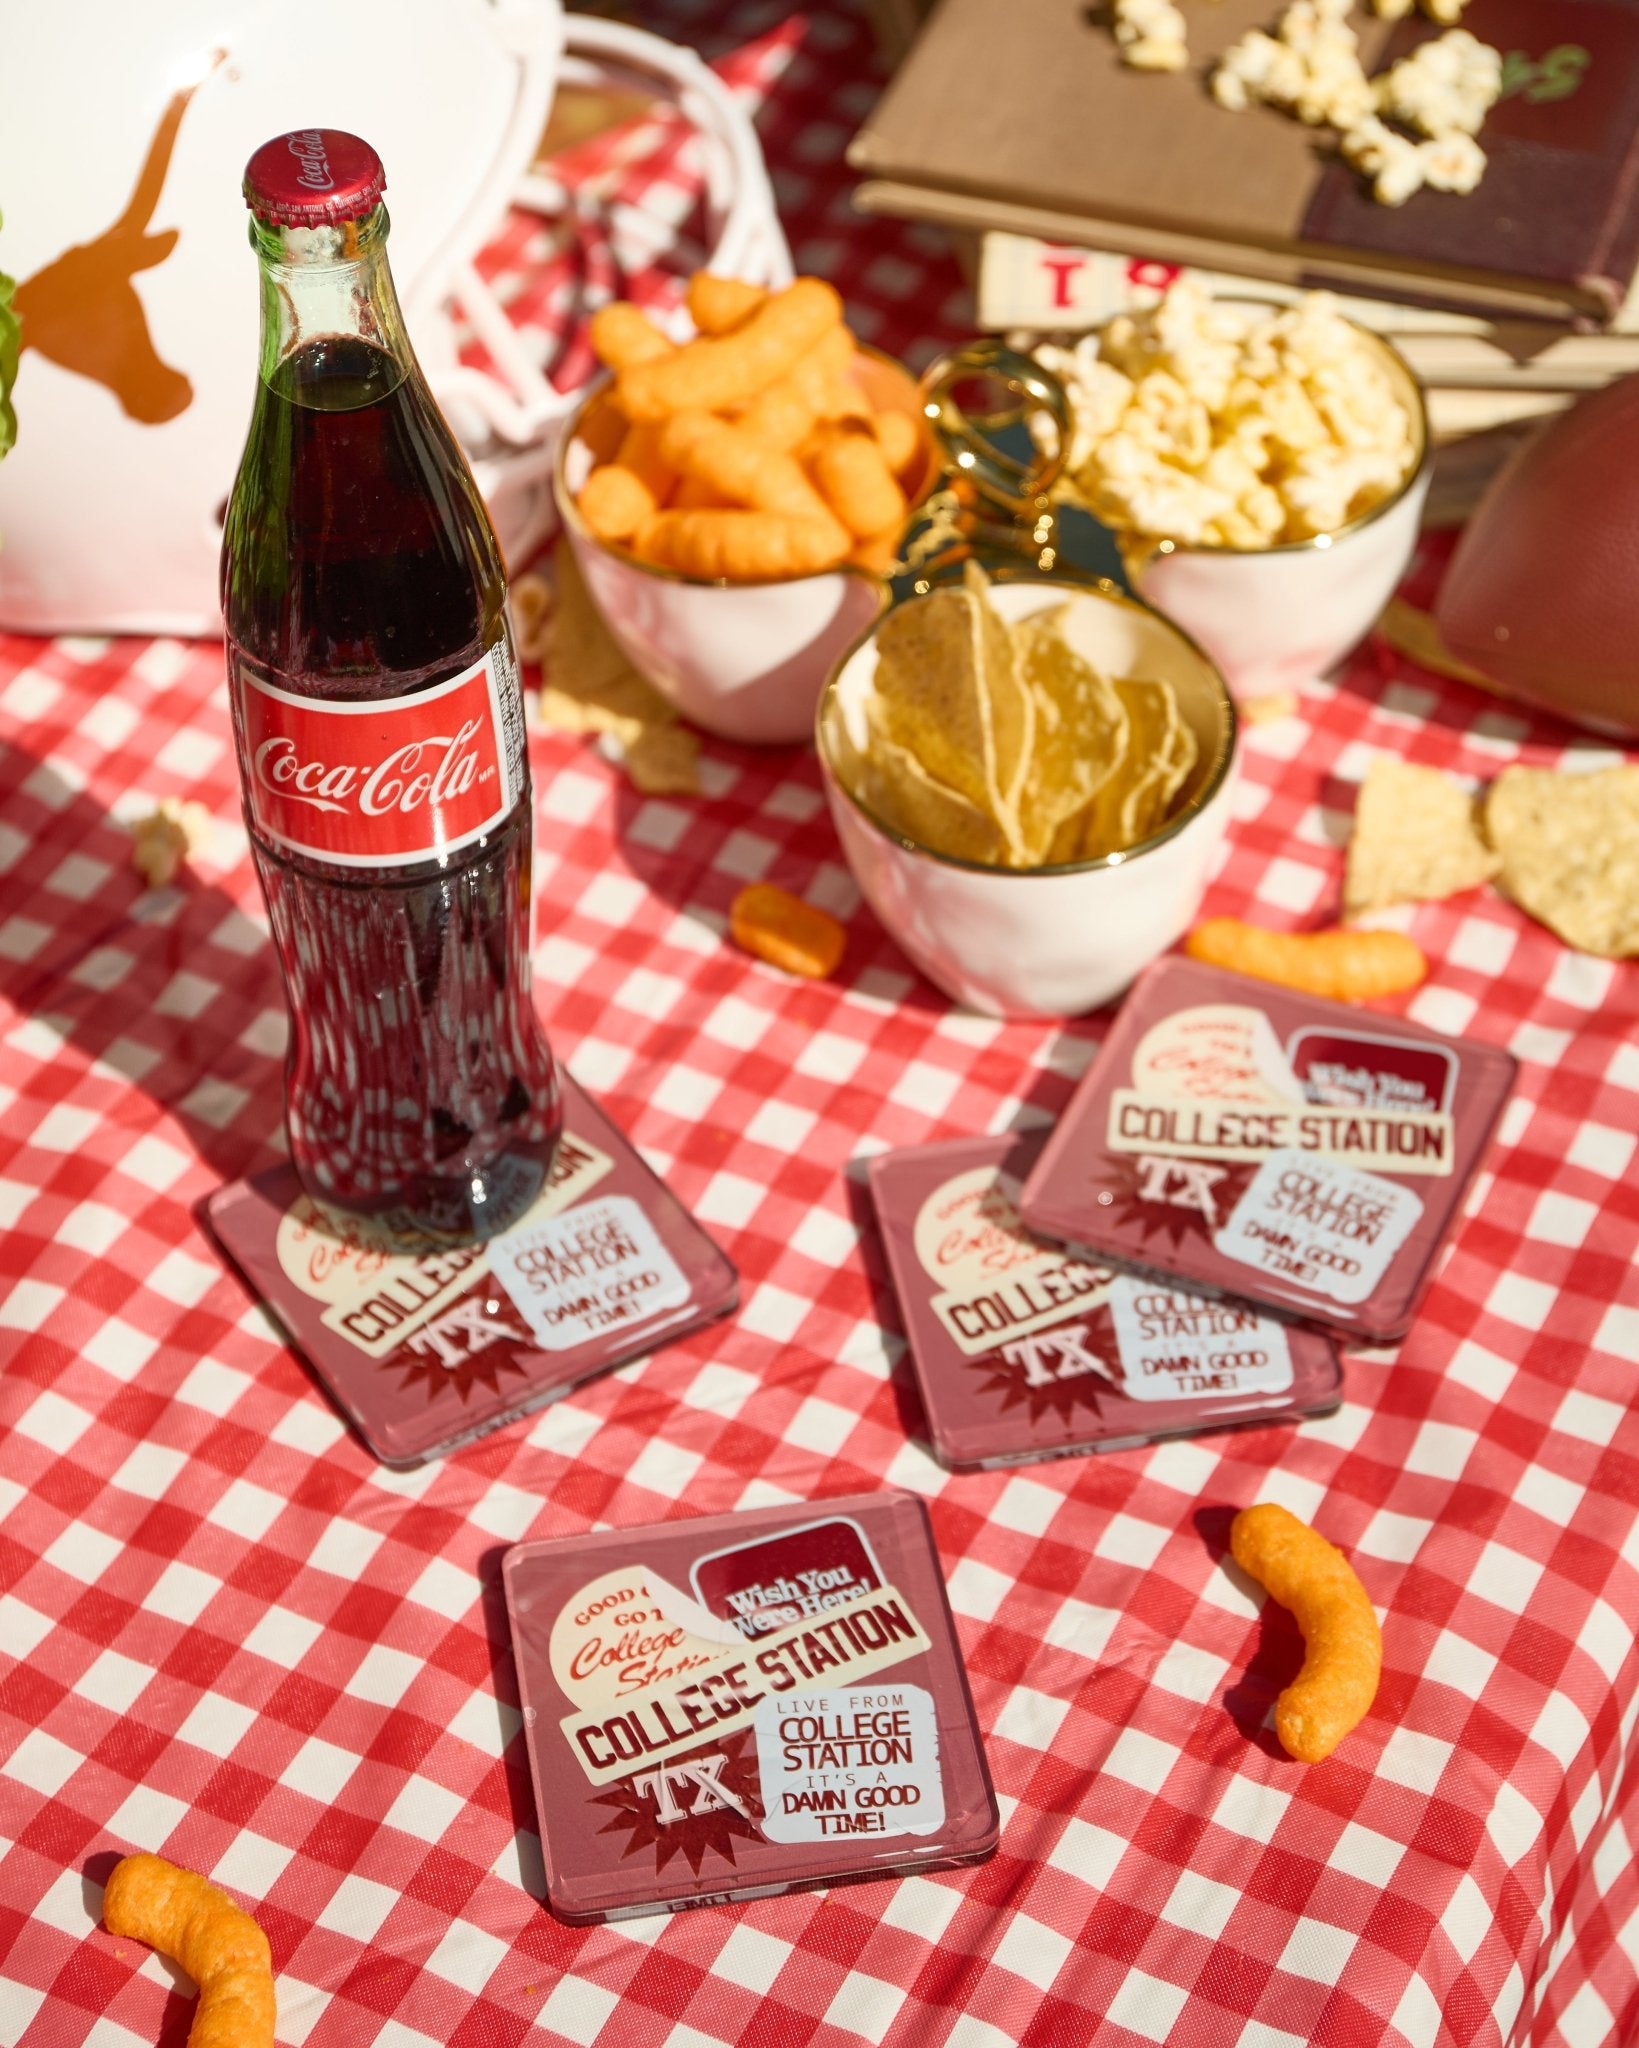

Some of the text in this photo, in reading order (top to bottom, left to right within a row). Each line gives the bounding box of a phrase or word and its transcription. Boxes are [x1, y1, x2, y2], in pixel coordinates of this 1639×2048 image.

[286, 131, 334, 189] Coca-Cola
[254, 713, 482, 816] Coca-Cola
[1120, 1104, 1444, 1160] COLLEGE STATION
[1137, 1155, 1228, 1222] TX
[1279, 1170, 1396, 1222] COLLEGE
[1265, 1190, 1383, 1245] STATION
[514, 1216, 622, 1274] COLLEGE
[526, 1234, 640, 1295] STATION
[1304, 1245, 1361, 1276] GOOD
[604, 1270, 661, 1301] GOOD
[406, 1297, 521, 1369] TX
[1139, 1311, 1258, 1340] STATION
[1001, 1323, 1115, 1387] TX
[1208, 1351, 1269, 1369] GOOD
[574, 1588, 635, 1626] GOOD
[725, 1565, 853, 1615] Wish You
[732, 1577, 872, 1636] Were Here!
[614, 1611, 647, 1626] GO
[570, 1628, 686, 1680] College
[576, 1600, 917, 1769] COLLEGE STATION
[777, 1694, 904, 1714] LIVE FROM
[779, 1711, 911, 1743] COLLEGE
[783, 1738, 913, 1771] STATION
[807, 1771, 888, 1788] IT'S A
[633, 1753, 748, 1826] TX
[782, 1785, 920, 1814] DAMN GOOD
[815, 1812, 886, 1834] TIME!
